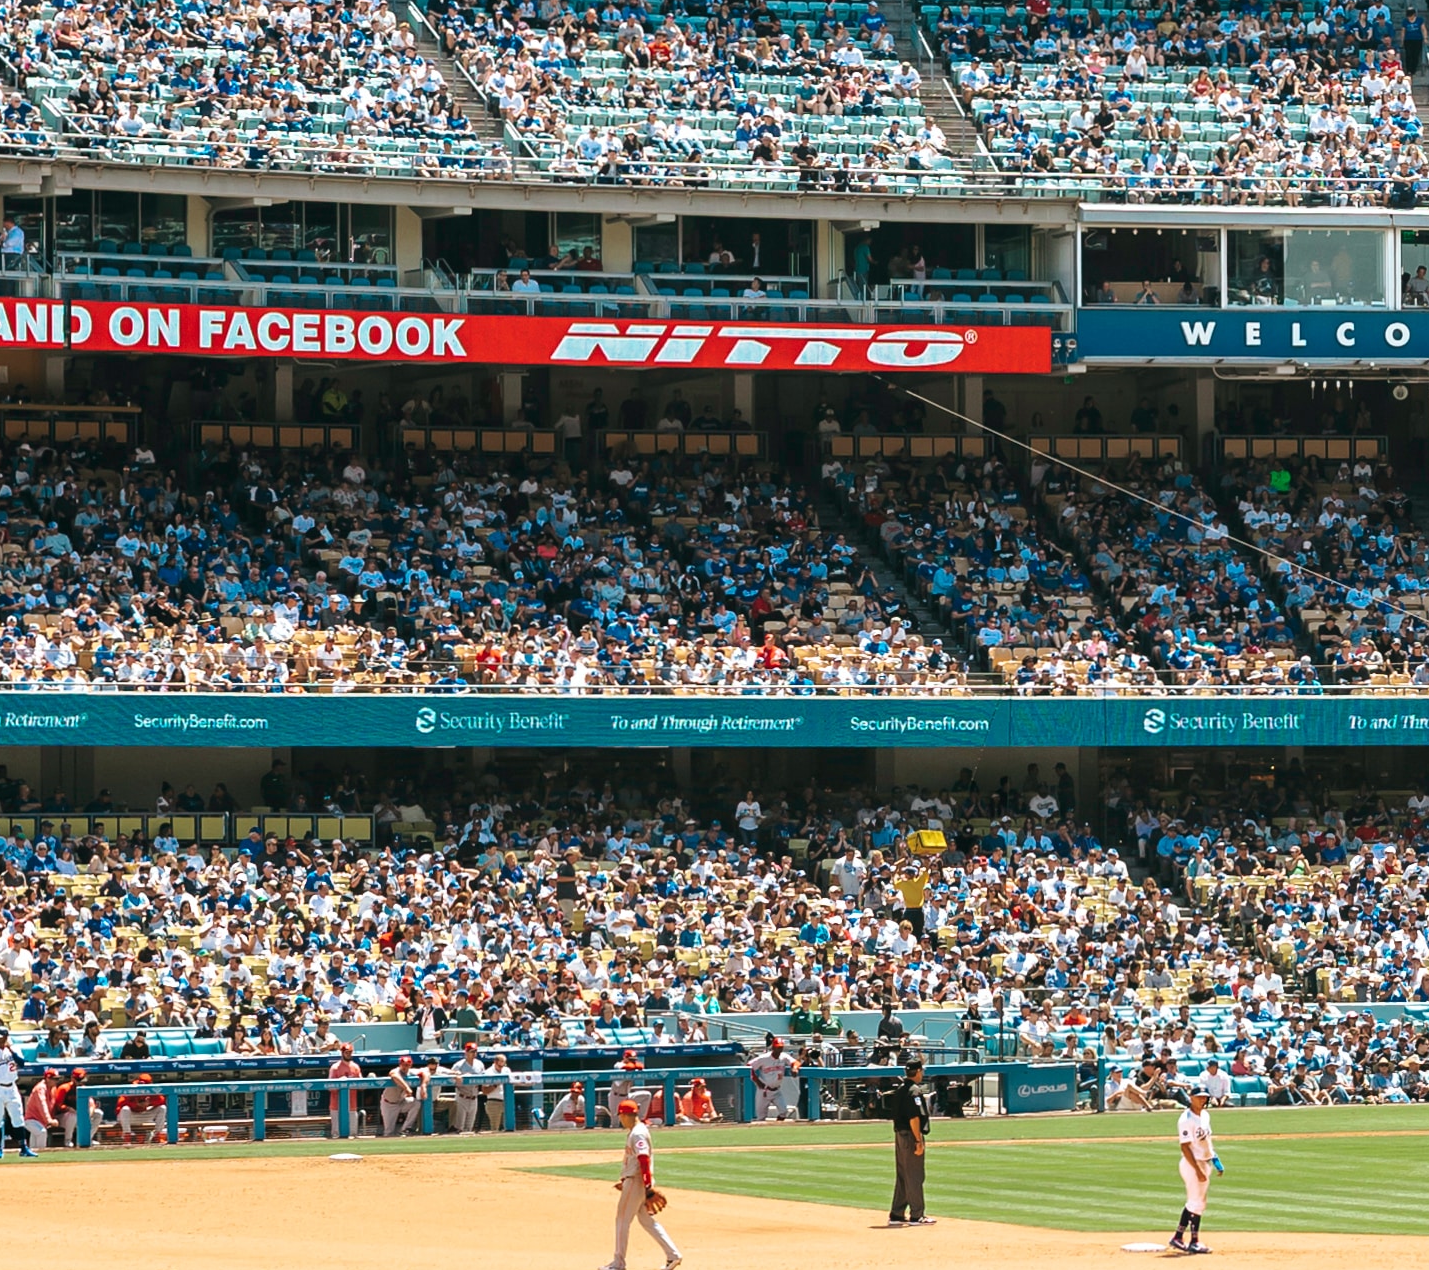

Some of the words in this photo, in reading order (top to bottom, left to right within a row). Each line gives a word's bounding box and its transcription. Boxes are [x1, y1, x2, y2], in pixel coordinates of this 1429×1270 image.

[108, 307, 173, 348] ON
[198, 309, 467, 359] FACEBOOK
[134, 713, 268, 732] SecurityBenefit.com
[440, 712, 505, 733] Security
[611, 716, 627, 731] To
[630, 715, 657, 731] and
[661, 715, 718, 733] Through
[850, 716, 989, 733] SecurityBenefit.com
[1170, 713, 1238, 733] Security
[1349, 715, 1367, 730] To
[1371, 715, 1397, 730] and
[1031, 1083, 1068, 1092] LEXUS
